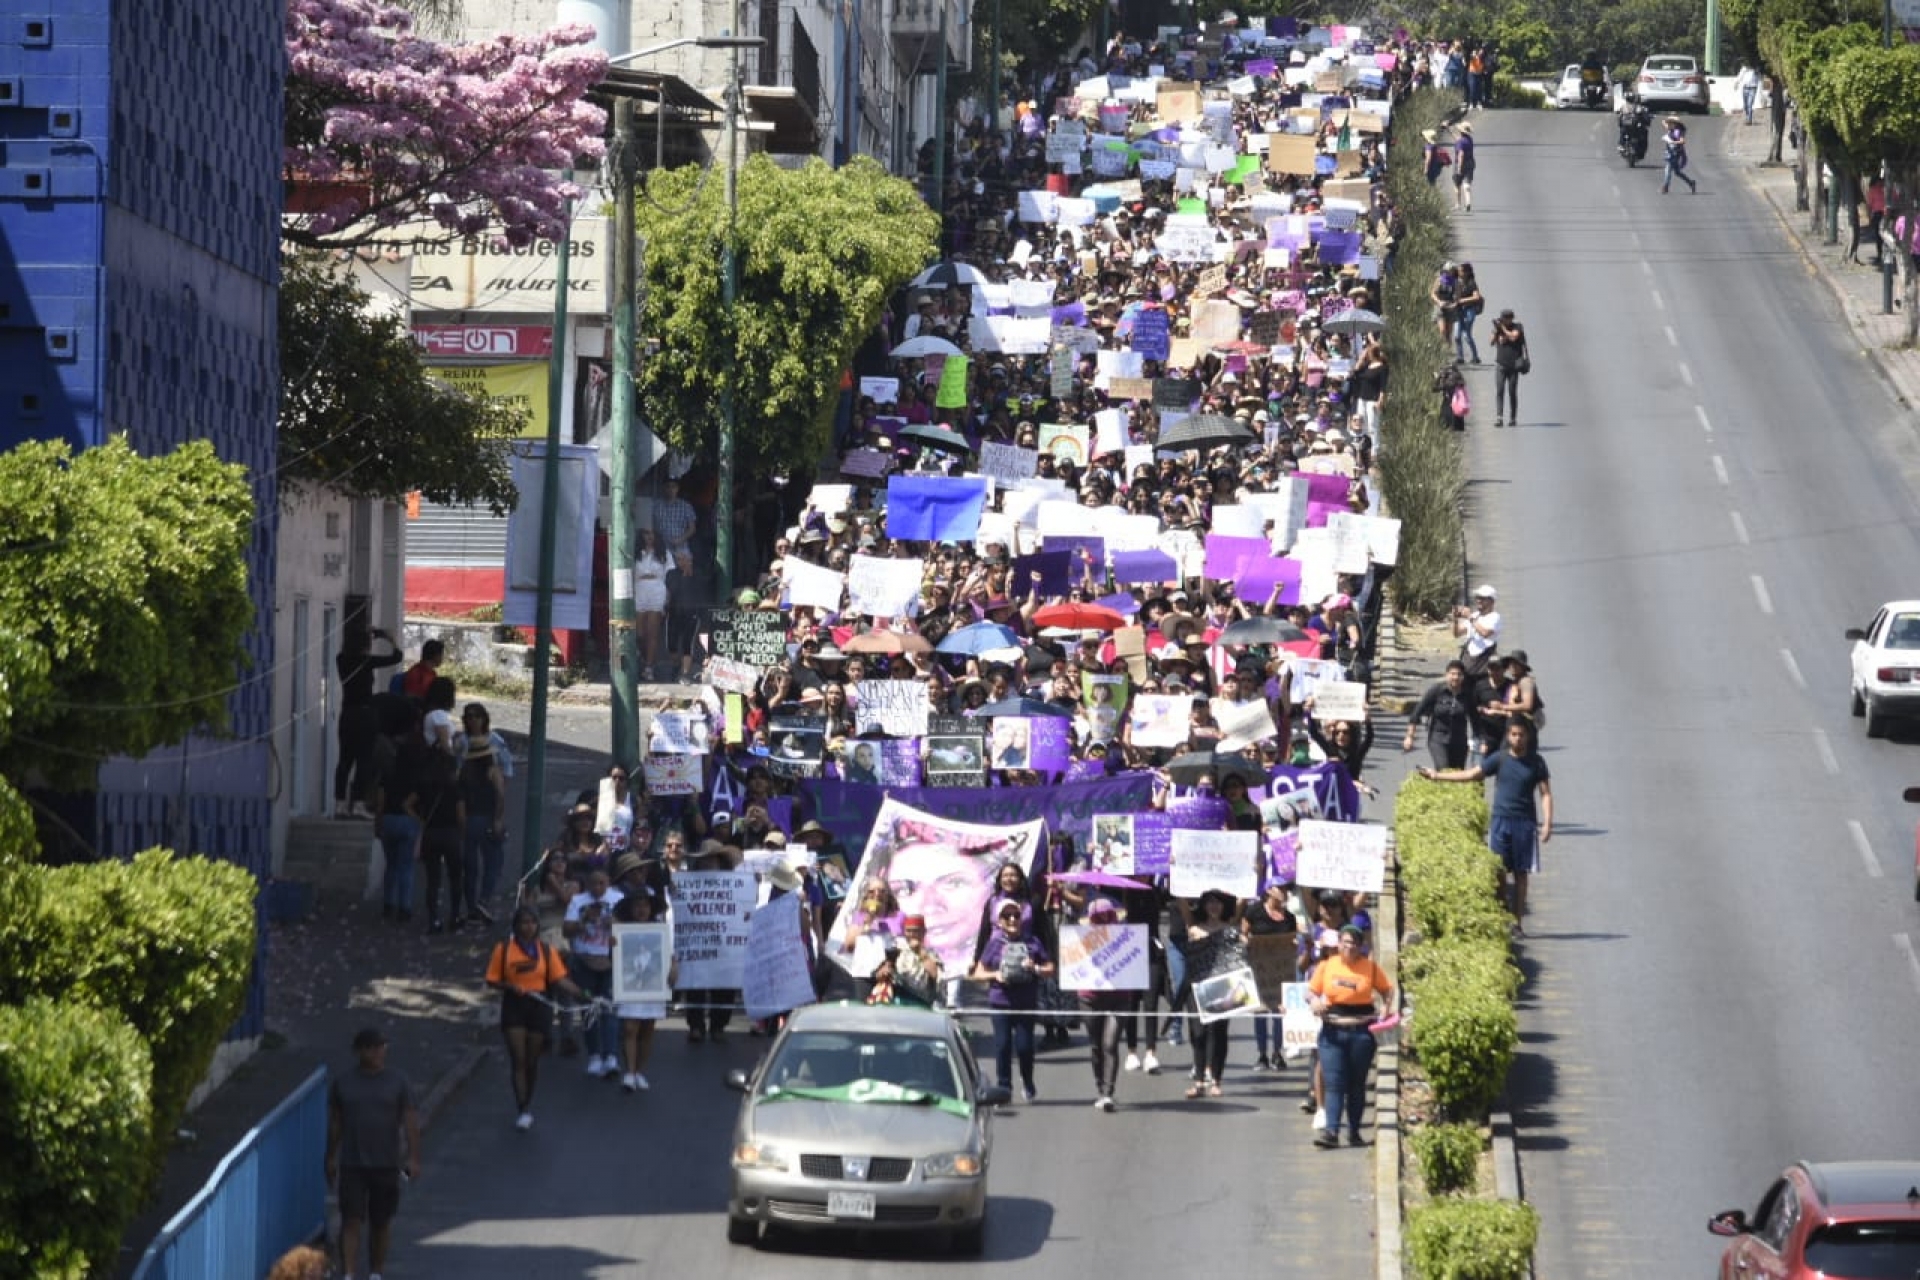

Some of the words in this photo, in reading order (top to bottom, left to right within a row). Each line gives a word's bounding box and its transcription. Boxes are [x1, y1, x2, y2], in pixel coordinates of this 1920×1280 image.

[461, 235, 595, 257] Biccleas
[444, 369, 487, 379] RENTA
[734, 611, 780, 622] QUITARON
[731, 621, 766, 631] TANTO
[714, 630, 732, 642] QUE
